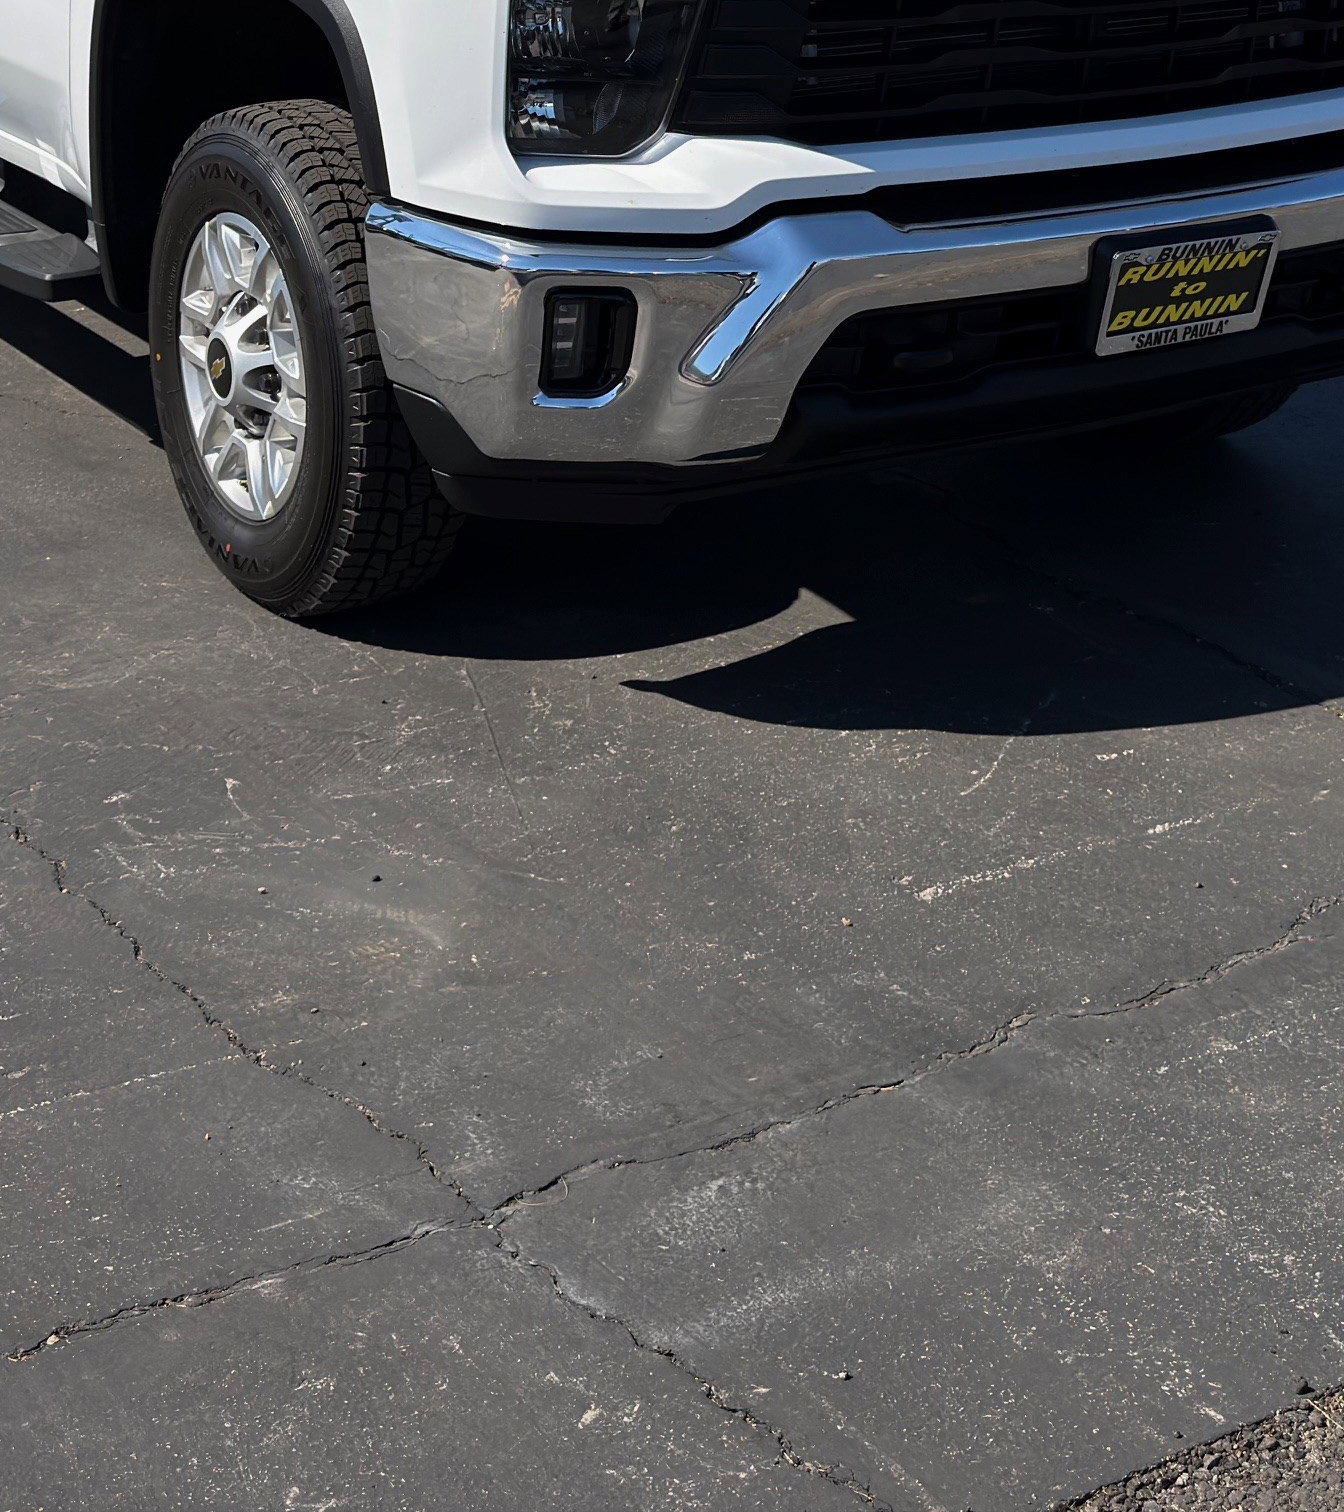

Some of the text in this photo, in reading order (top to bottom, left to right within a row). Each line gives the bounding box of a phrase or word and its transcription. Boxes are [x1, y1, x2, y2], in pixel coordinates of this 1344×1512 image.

[1157, 237, 1242, 263] BUNNIN
[1117, 248, 1267, 287] RUNNIN'
[1170, 281, 1207, 297] to
[1107, 291, 1249, 332] BUNNIN
